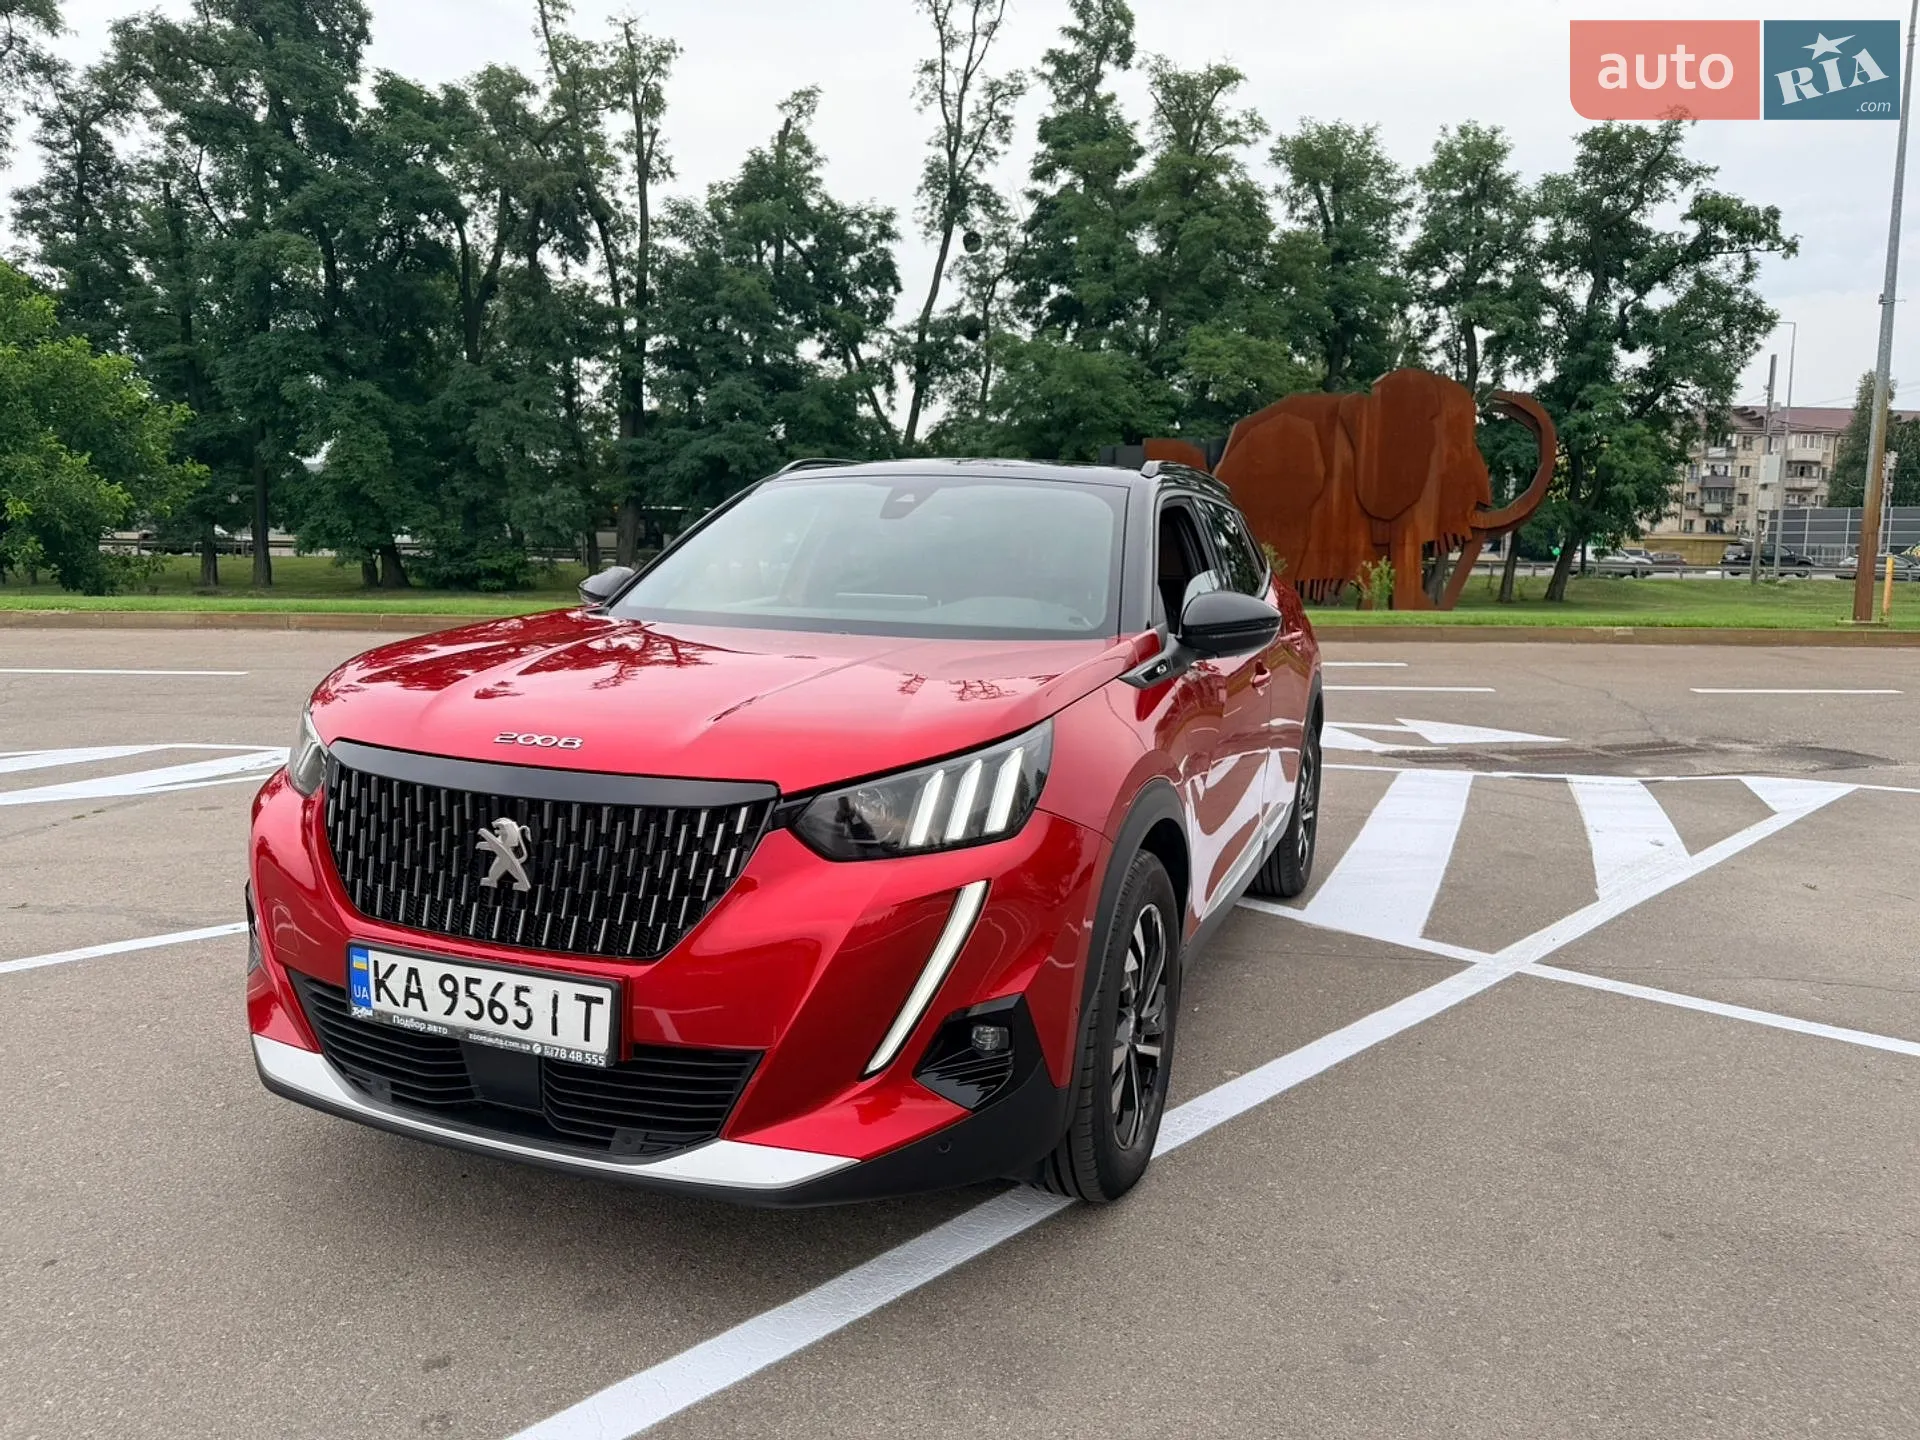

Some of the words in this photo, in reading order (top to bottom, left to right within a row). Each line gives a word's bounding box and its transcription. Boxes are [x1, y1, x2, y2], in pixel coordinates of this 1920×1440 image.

[493, 731, 584, 750] 2008
[353, 983, 370, 1000] UA
[373, 959, 428, 1013] KA
[438, 973, 533, 1031] 9565
[392, 1014, 426, 1032] Подбор
[427, 1022, 448, 1035] авто
[568, 1050, 583, 1062] 48
[585, 1053, 606, 1066] 555
